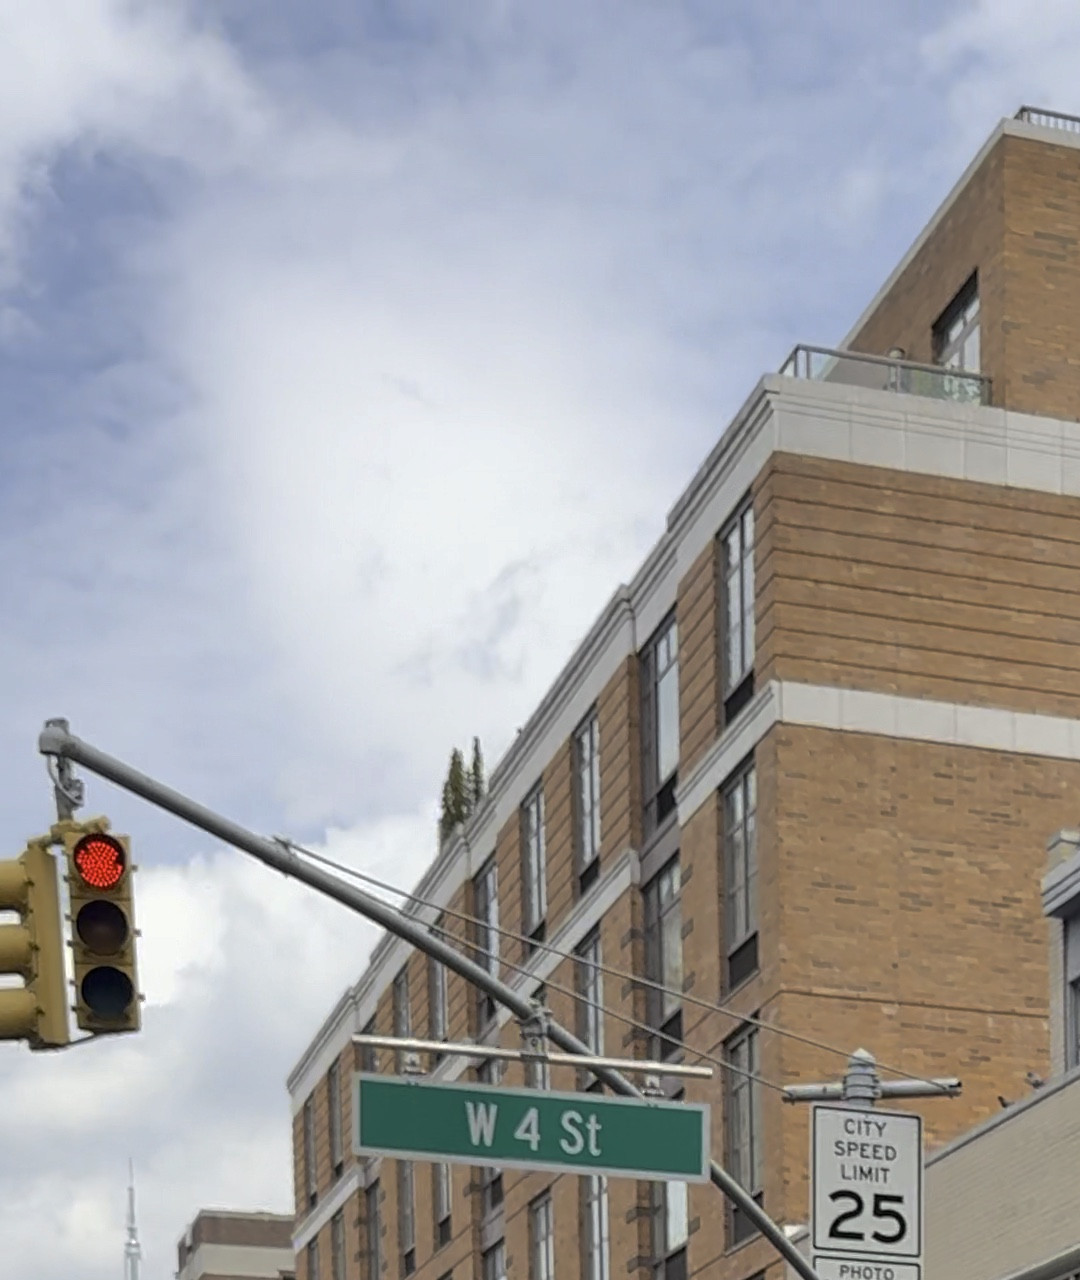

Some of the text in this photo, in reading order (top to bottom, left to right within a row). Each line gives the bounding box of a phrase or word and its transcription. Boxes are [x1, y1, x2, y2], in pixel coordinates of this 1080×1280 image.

[464, 1101, 602, 1157] W 4 St
[844, 1118, 887, 1137] CITY
[834, 1141, 897, 1161] SPEED
[841, 1164, 890, 1184] LIMIT
[828, 1190, 907, 1244] 25
